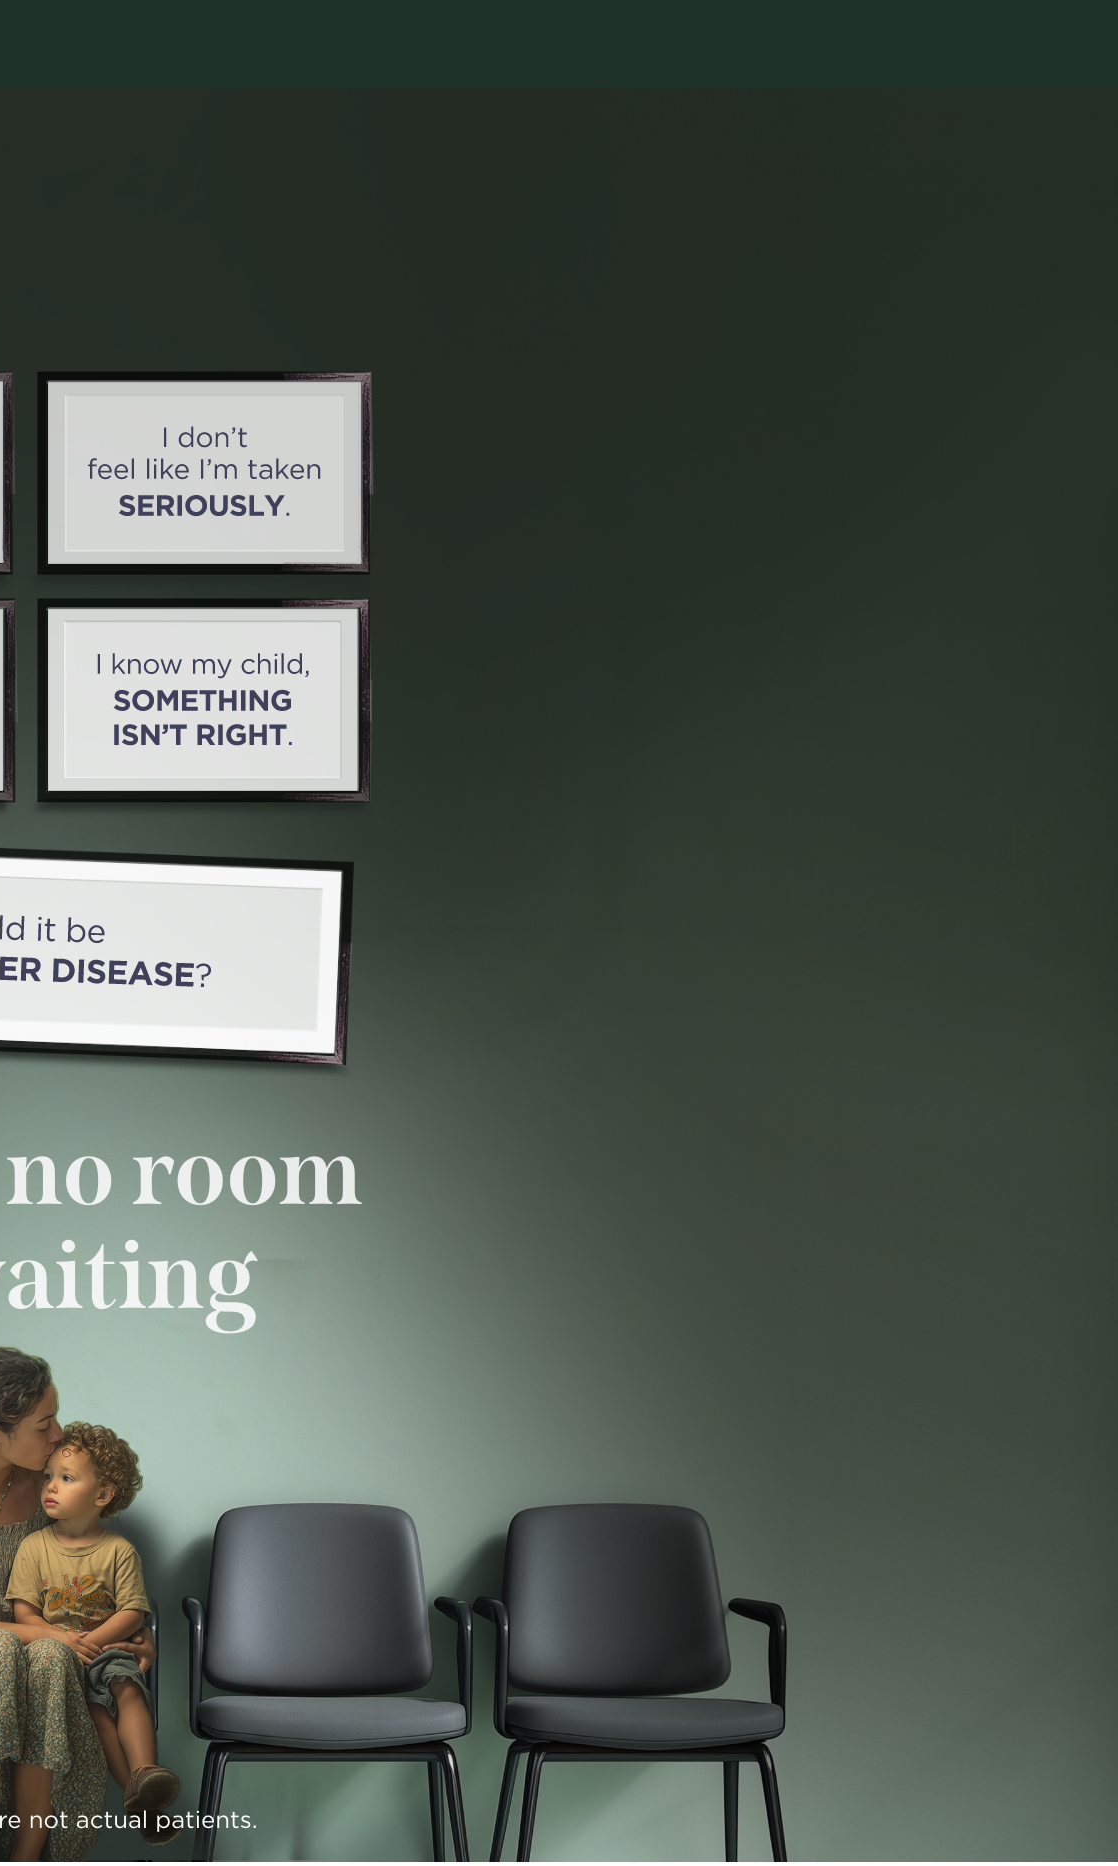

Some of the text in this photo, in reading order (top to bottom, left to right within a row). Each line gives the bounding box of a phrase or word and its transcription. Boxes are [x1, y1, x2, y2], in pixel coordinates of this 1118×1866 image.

[178, 425, 248, 448] don’t
[87, 457, 321, 480] feel like I’m taken
[118, 494, 290, 517] SERIOUSLY.
[112, 652, 183, 675] know
[192, 658, 233, 679] my
[240, 652, 310, 678] child,
[113, 689, 292, 712] SOMETHING
[113, 723, 293, 746] ISN’T RIGHT.
[37, 916, 56, 943] it
[67, 916, 106, 944] be
[52, 957, 212, 988] DISEASE?
